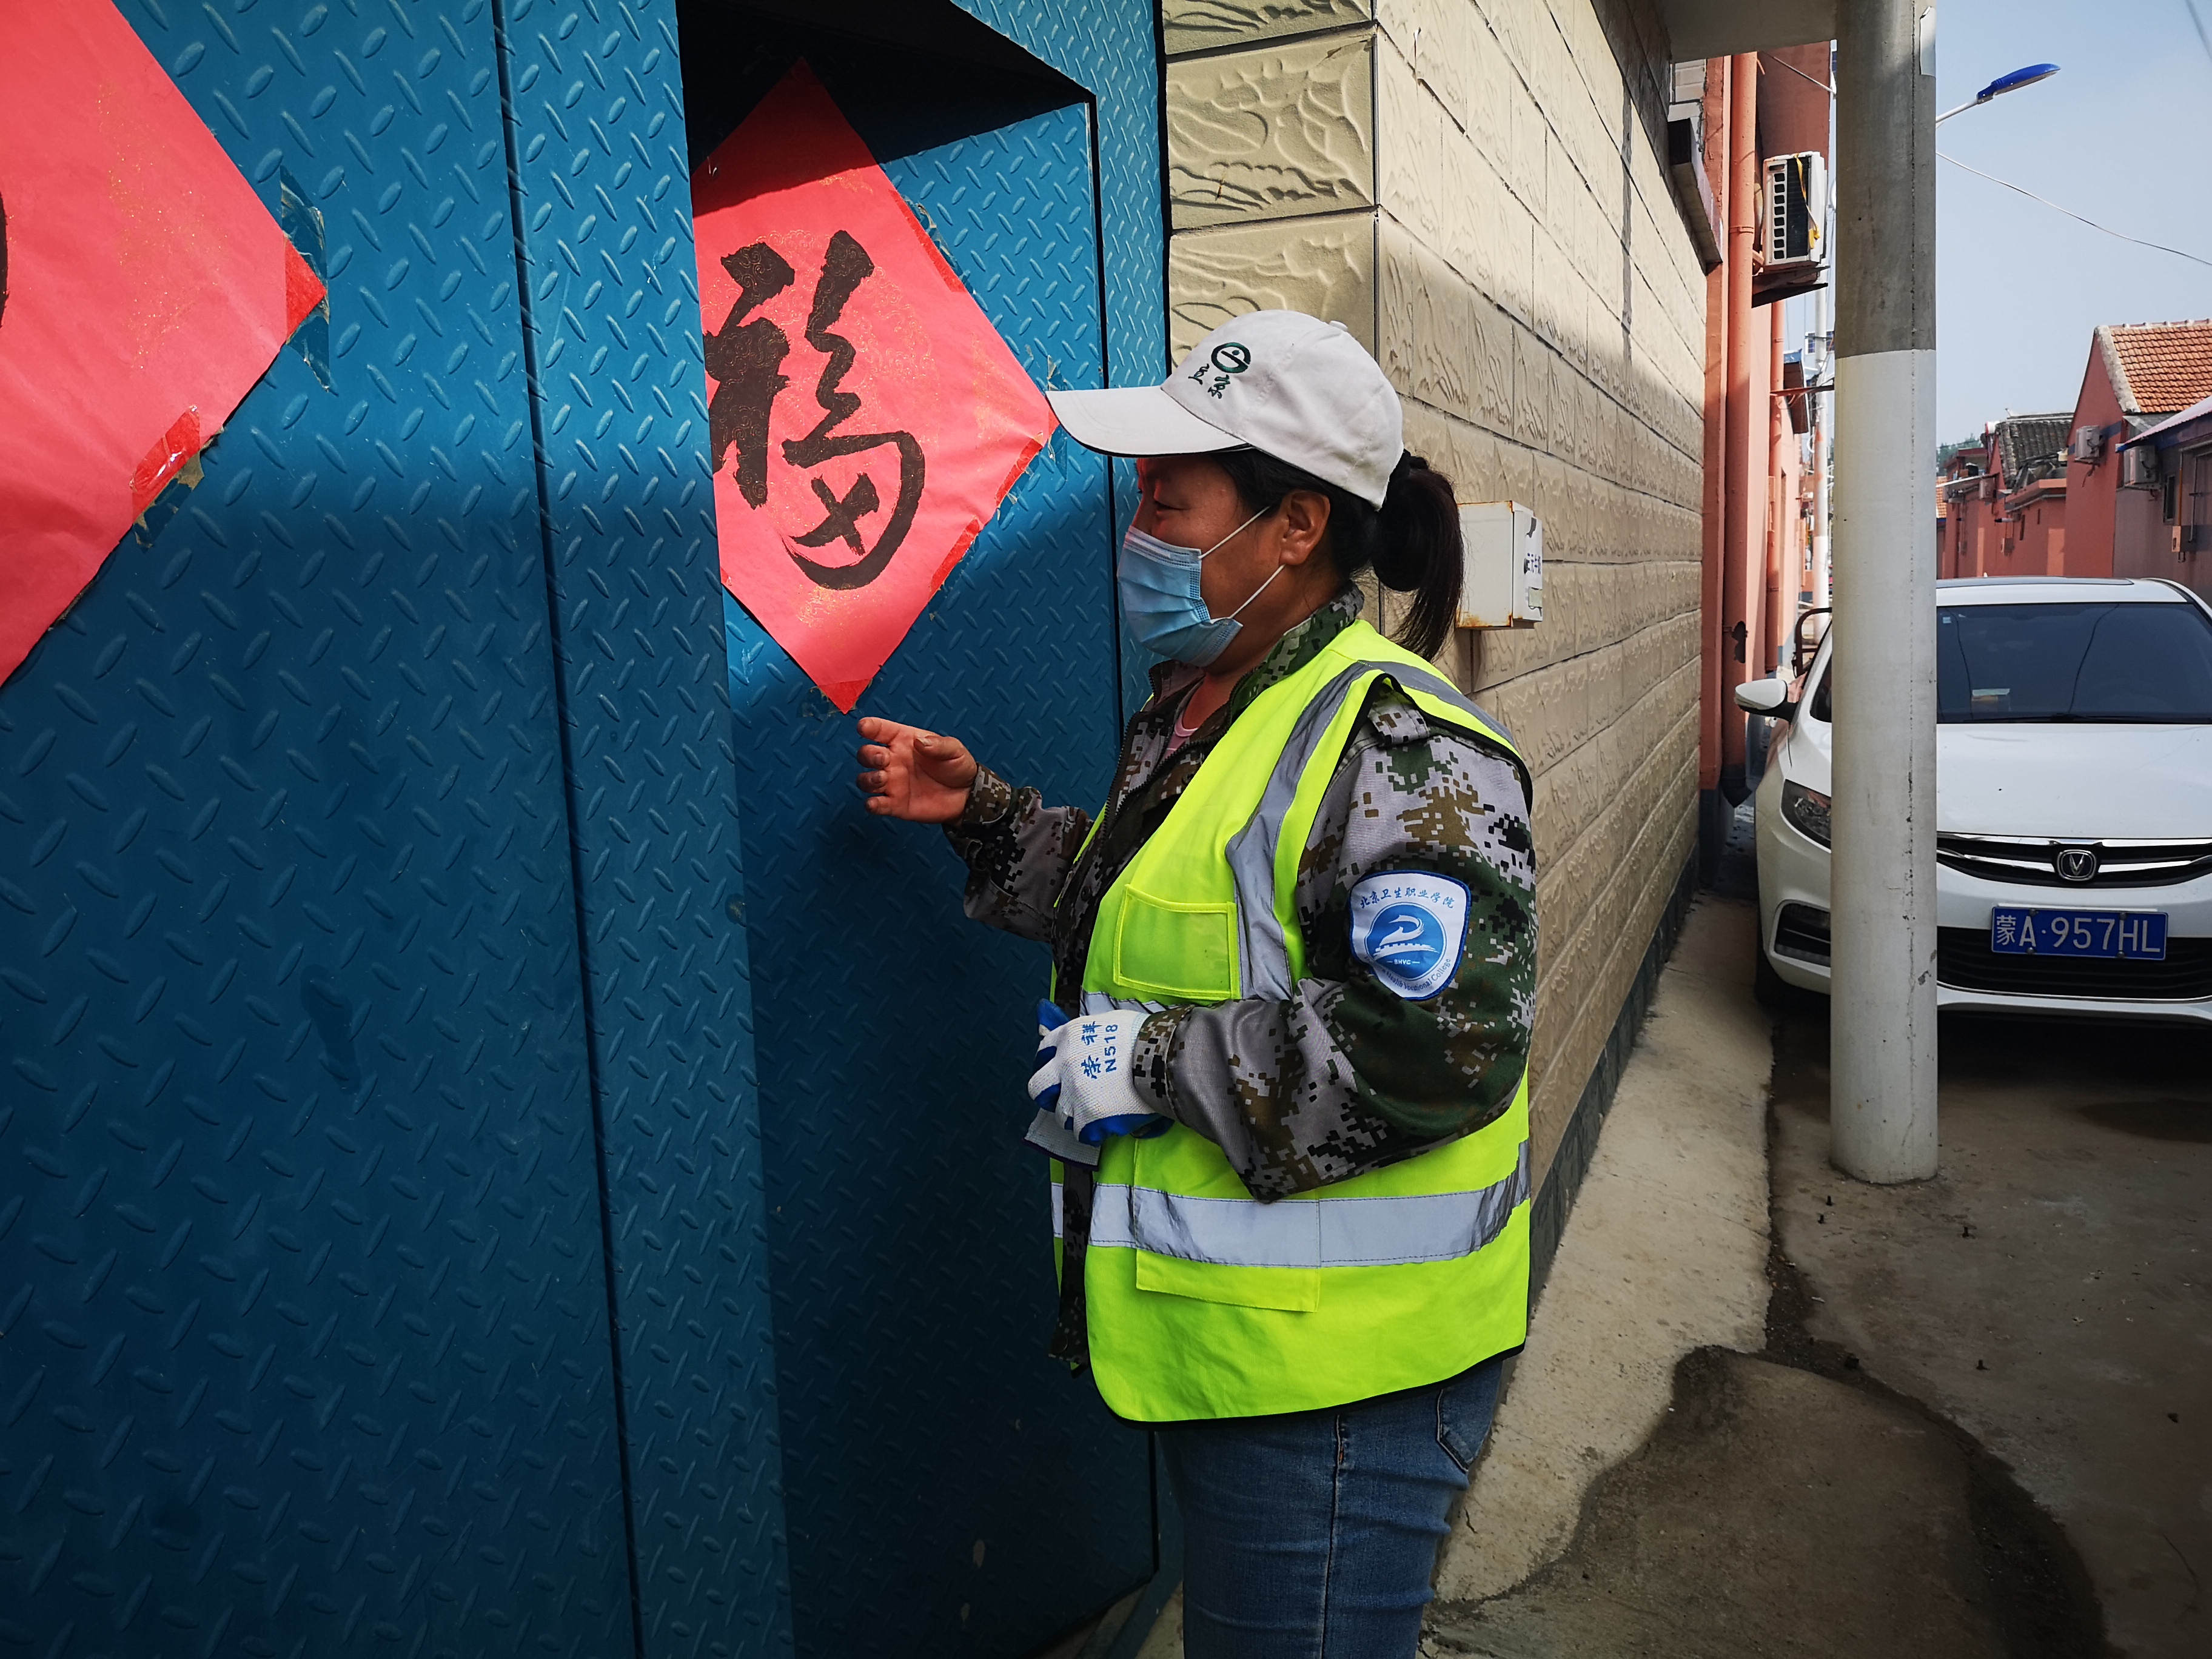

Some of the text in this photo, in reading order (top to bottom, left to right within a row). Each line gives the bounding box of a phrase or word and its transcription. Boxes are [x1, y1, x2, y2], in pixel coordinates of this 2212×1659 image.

[703, 230, 925, 590] 福
[1360, 887, 1455, 909] 北京卫生职业学院
[1996, 914, 2160, 953] 蒙A·957HL
[1431, 958, 1451, 981] College
[1081, 1021, 1102, 1079] 荣祥
[1104, 1024, 1118, 1073] N518
